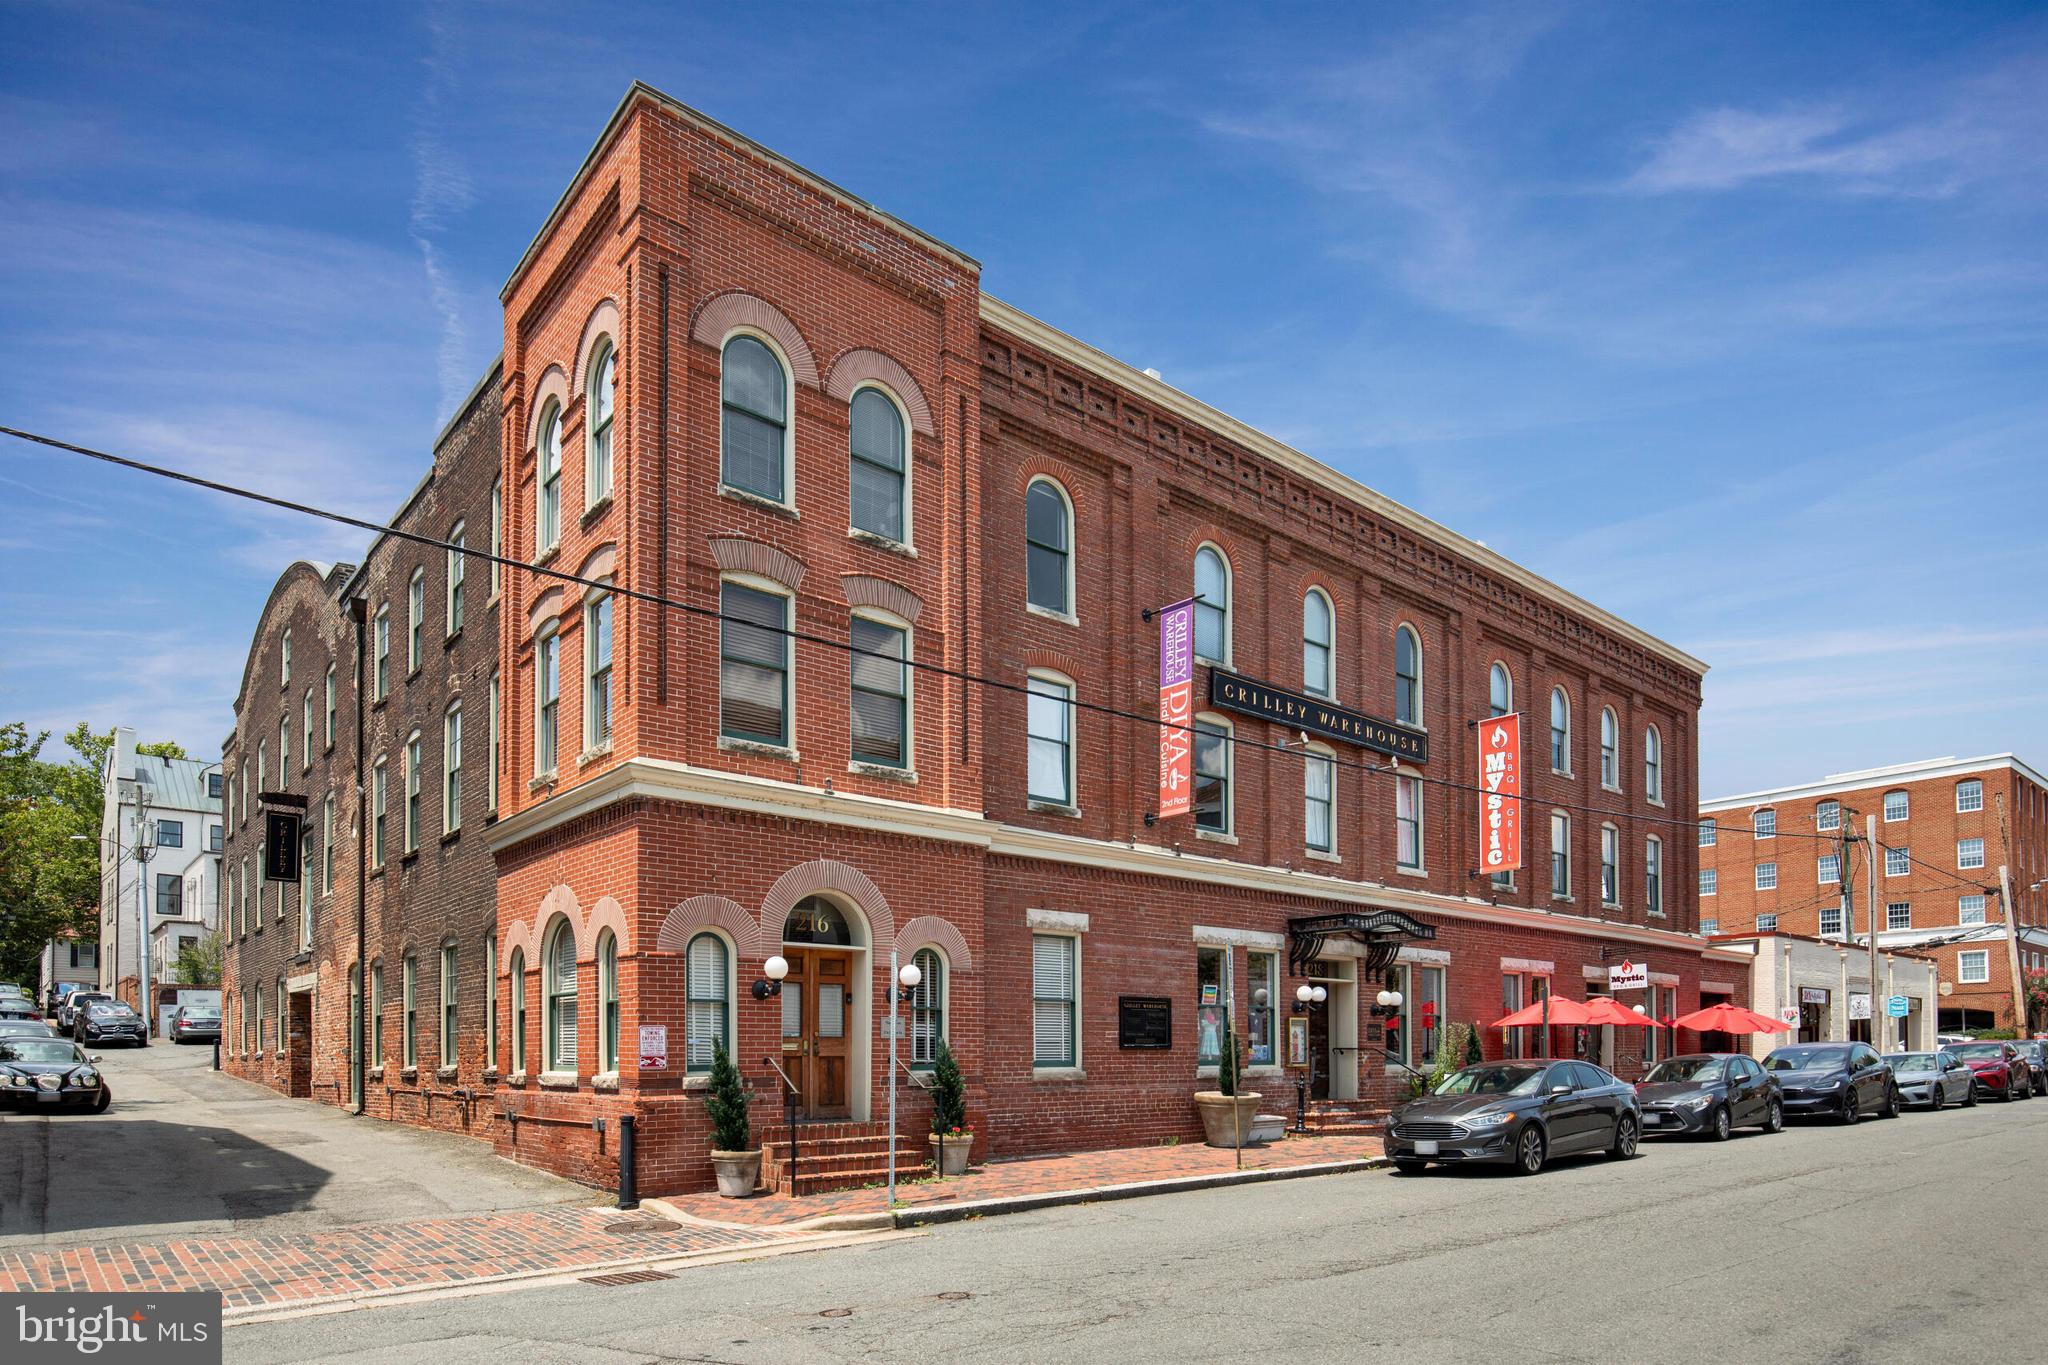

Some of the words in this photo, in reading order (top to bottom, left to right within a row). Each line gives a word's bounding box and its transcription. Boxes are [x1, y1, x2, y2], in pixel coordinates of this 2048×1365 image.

[1165, 614, 1175, 684] WAREHOUSE
[1174, 609, 1188, 679] CRILLEY
[1169, 687, 1188, 766] DIYA
[1224, 683, 1307, 719] CRILLEY
[1317, 711, 1419, 752] WAREHOUSE
[1160, 741, 1169, 789] Cuisine
[1506, 752, 1515, 784] BBQ
[1161, 799, 1173, 808] 2nd
[1173, 796, 1188, 806] Floor
[1485, 752, 1506, 866] Mystic
[1506, 808, 1515, 863] GRILL
[795, 910, 829, 933] 216
[1611, 974, 1645, 984] Mystic
